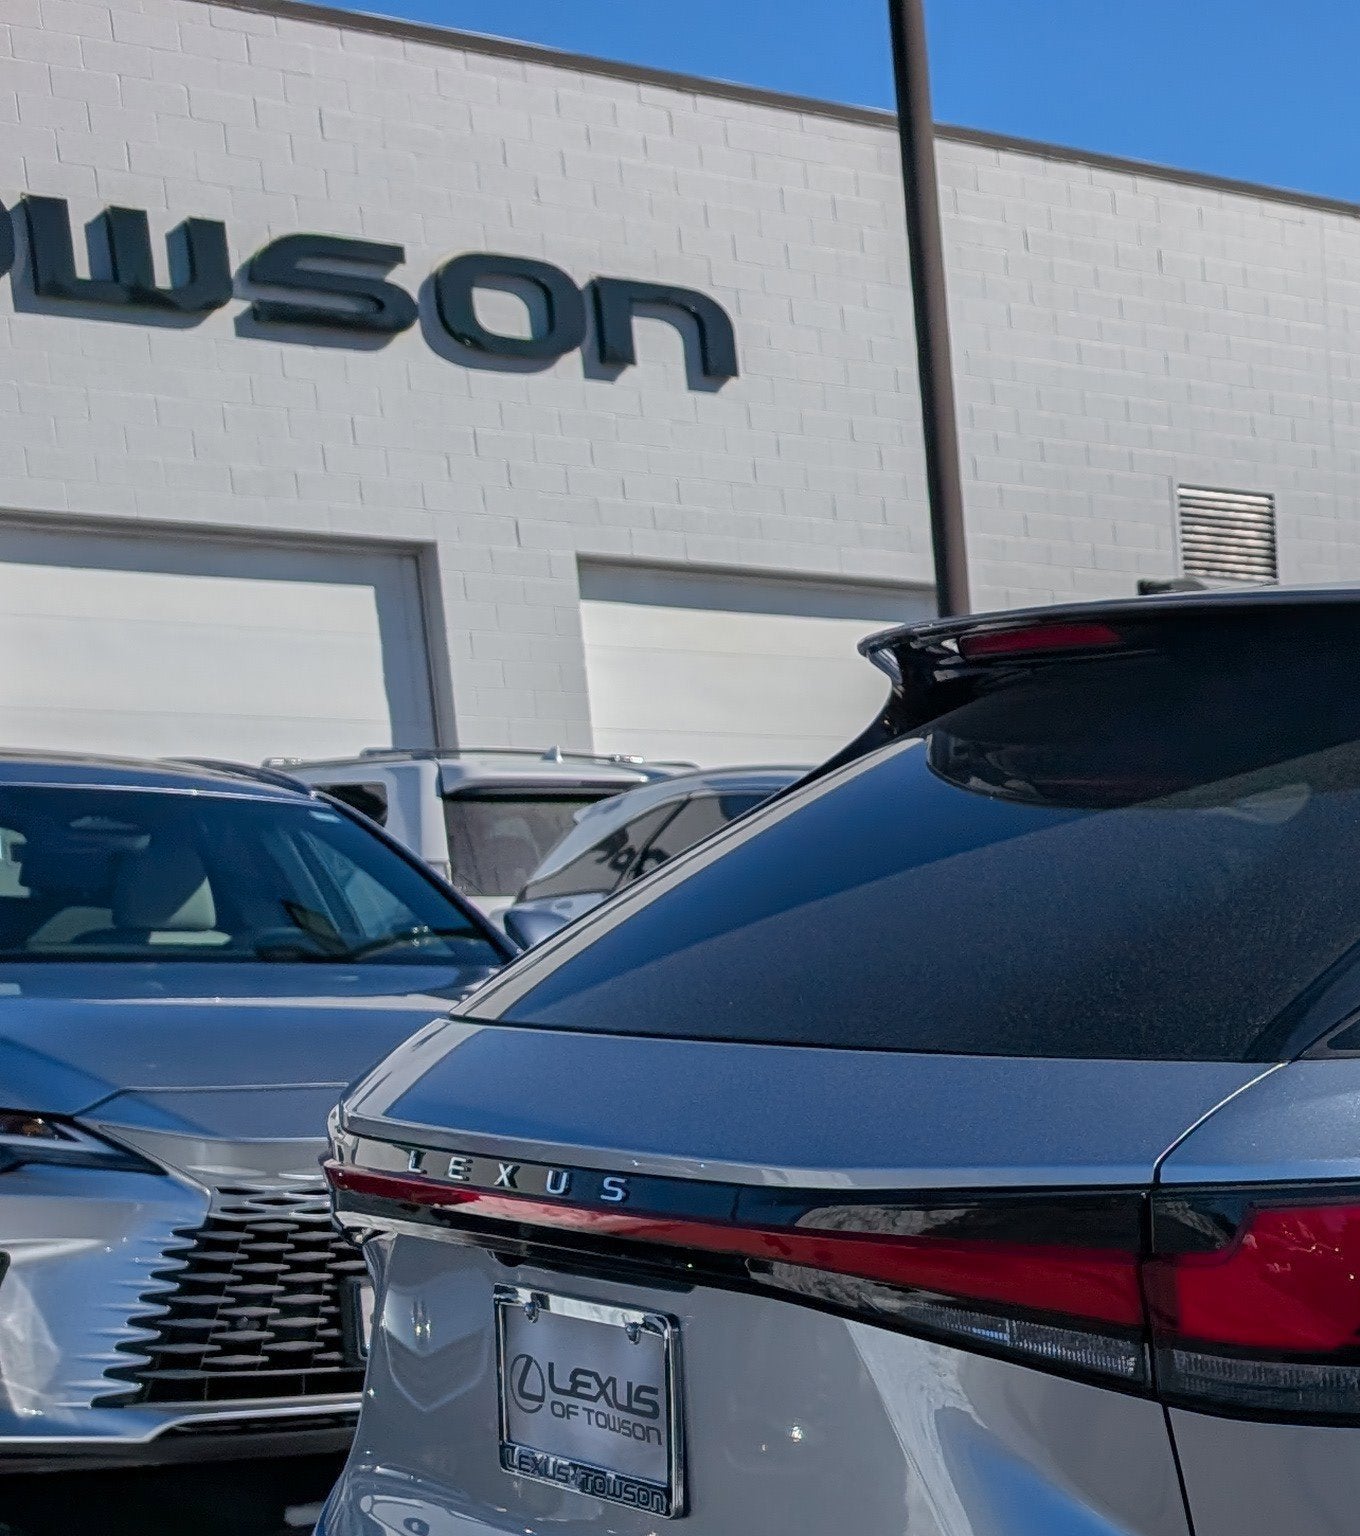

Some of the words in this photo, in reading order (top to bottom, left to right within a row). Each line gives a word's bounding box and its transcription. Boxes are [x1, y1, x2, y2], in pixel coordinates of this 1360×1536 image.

[406, 1150, 630, 1202] LEXUS
[547, 1361, 660, 1420] LEXUS
[550, 1400, 579, 1420] OF
[582, 1406, 663, 1446] TOWSON
[504, 1447, 570, 1484] LEXUS
